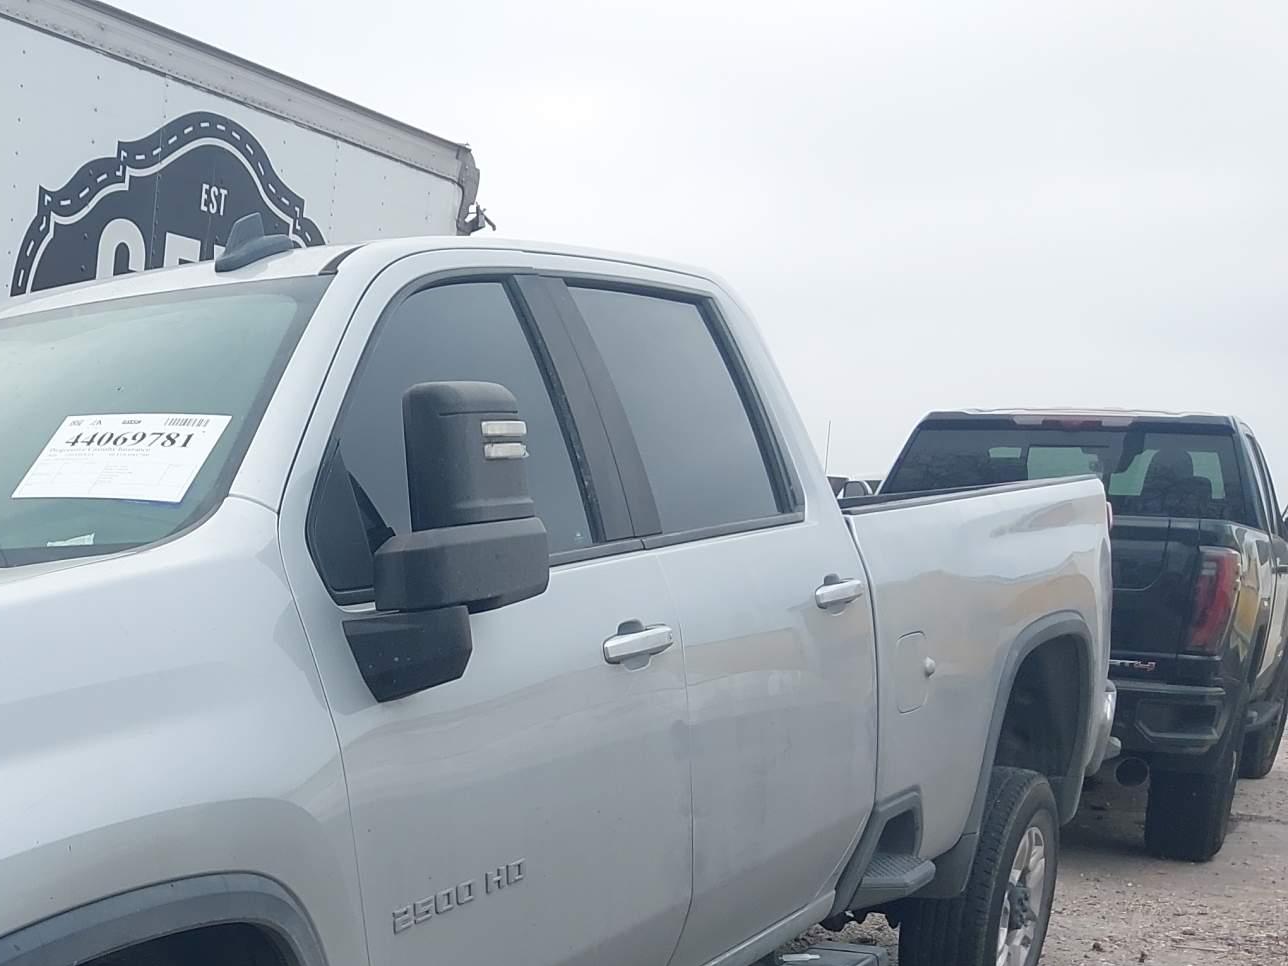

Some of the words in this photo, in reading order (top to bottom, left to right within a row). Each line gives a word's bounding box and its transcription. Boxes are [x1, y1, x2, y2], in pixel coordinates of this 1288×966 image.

[200, 183, 228, 216] EST
[65, 431, 194, 448] 44069781
[392, 879, 475, 935] 2500
[485, 857, 526, 895] HD
